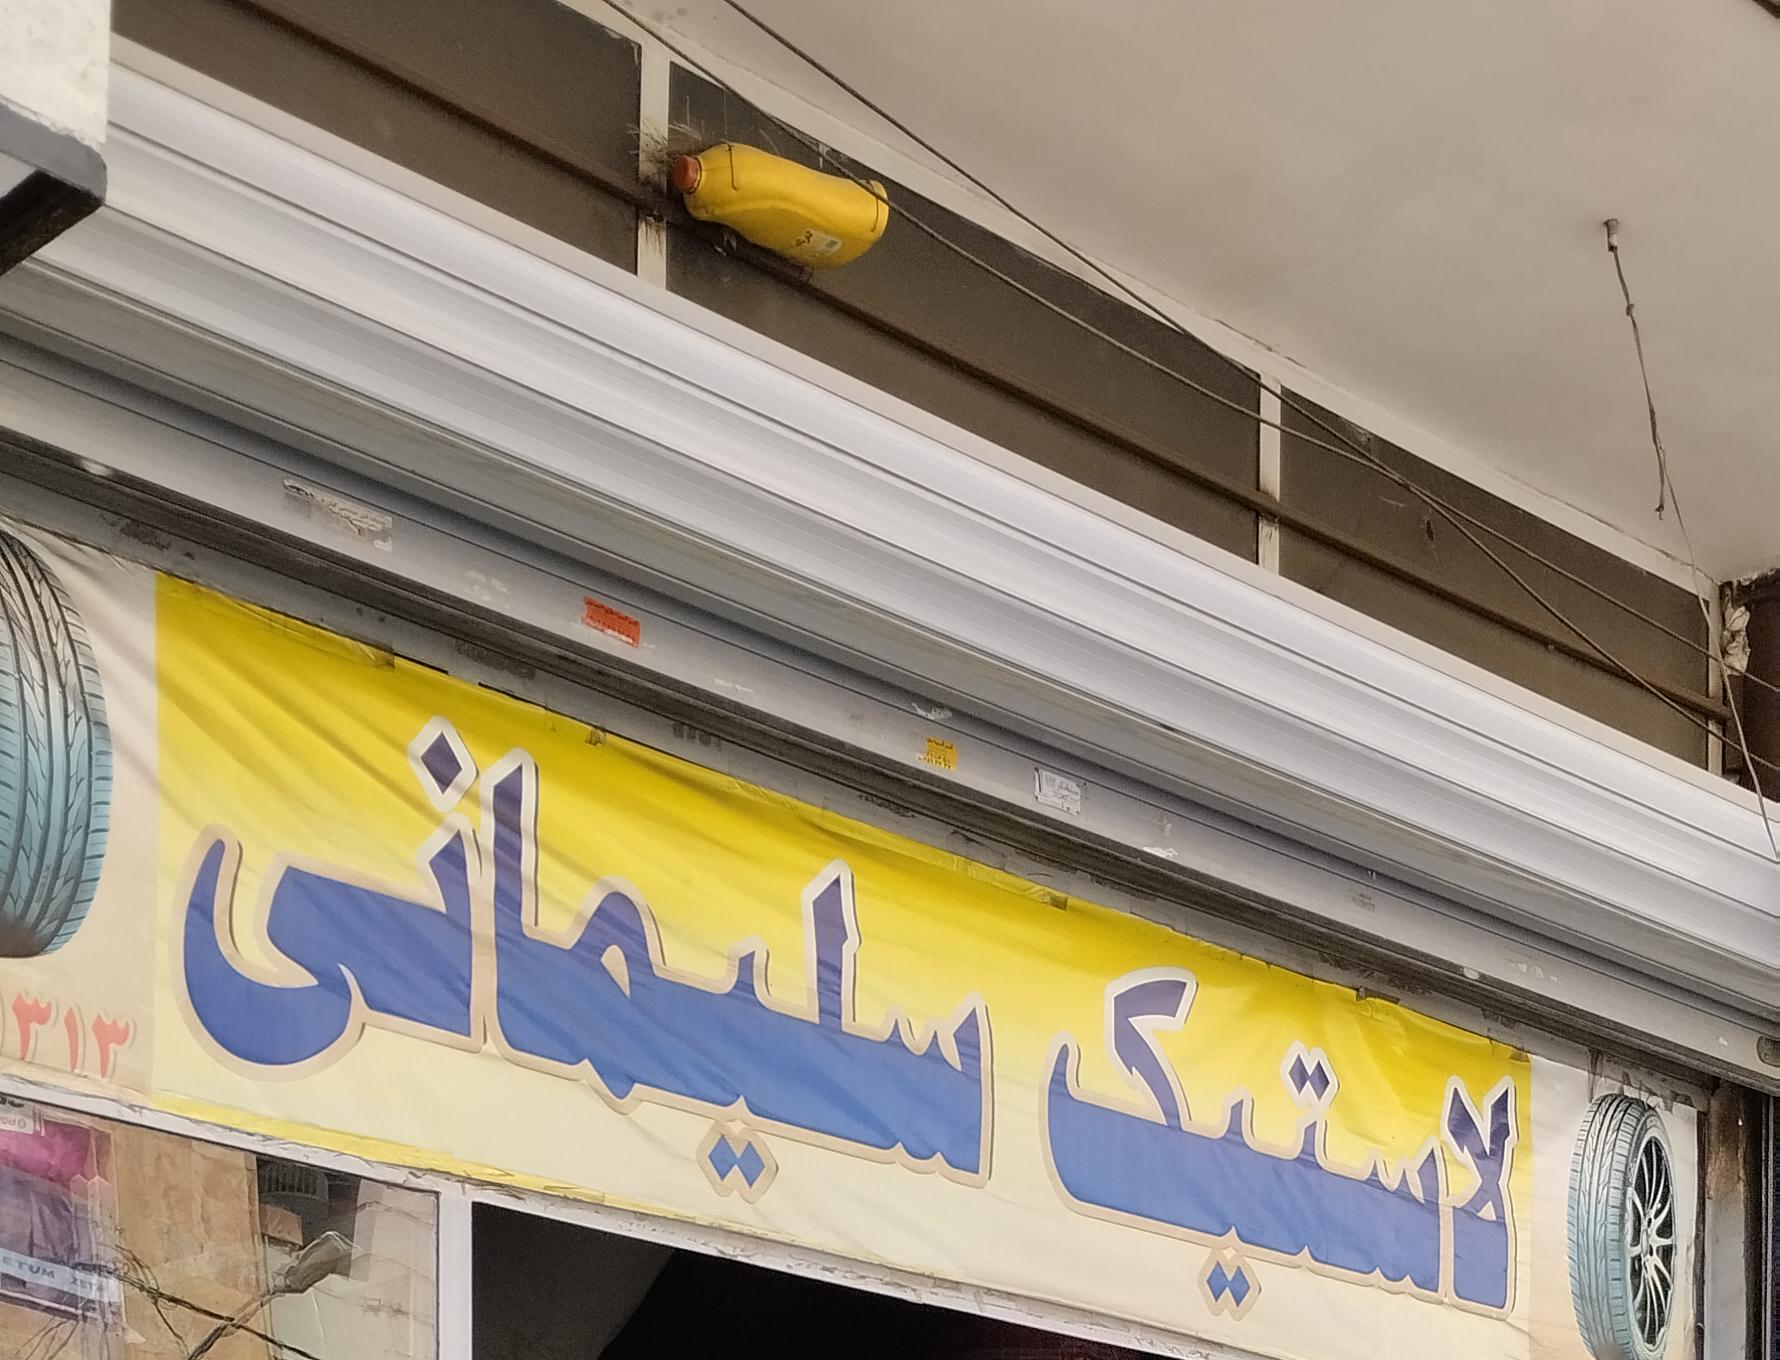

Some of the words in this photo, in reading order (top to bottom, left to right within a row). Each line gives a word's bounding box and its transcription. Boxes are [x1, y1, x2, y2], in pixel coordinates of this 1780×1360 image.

[0, 992, 131, 1079] ۳۱۳
[180, 722, 988, 1198] سلیمانی
[1043, 972, 1514, 1316] لاستیک
